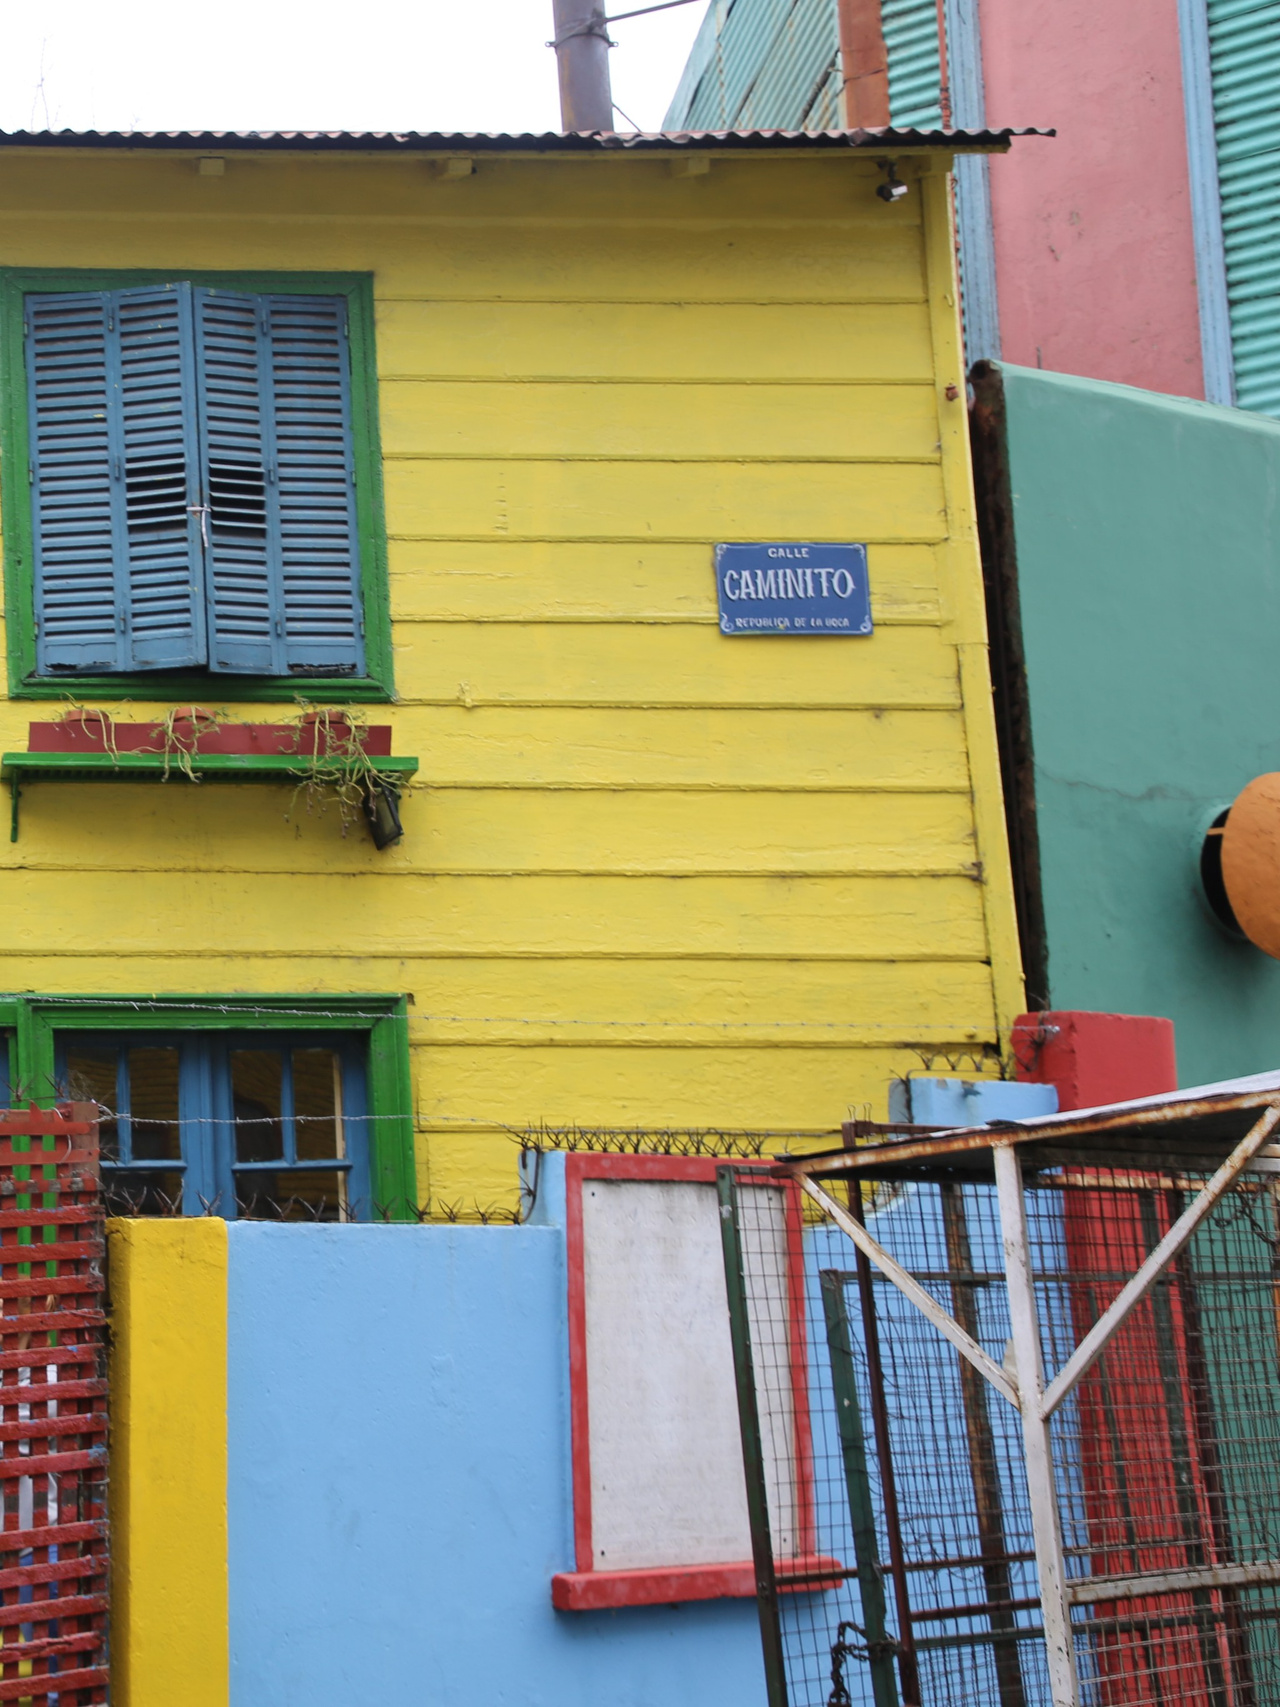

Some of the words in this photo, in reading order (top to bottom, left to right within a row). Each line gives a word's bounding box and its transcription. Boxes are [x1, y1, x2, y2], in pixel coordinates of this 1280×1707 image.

[767, 547, 810, 559] CALLE
[723, 567, 856, 601] CAMINITO
[735, 617, 791, 629] REPUBLICA
[794, 617, 807, 628] DE
[810, 617, 823, 628] LA
